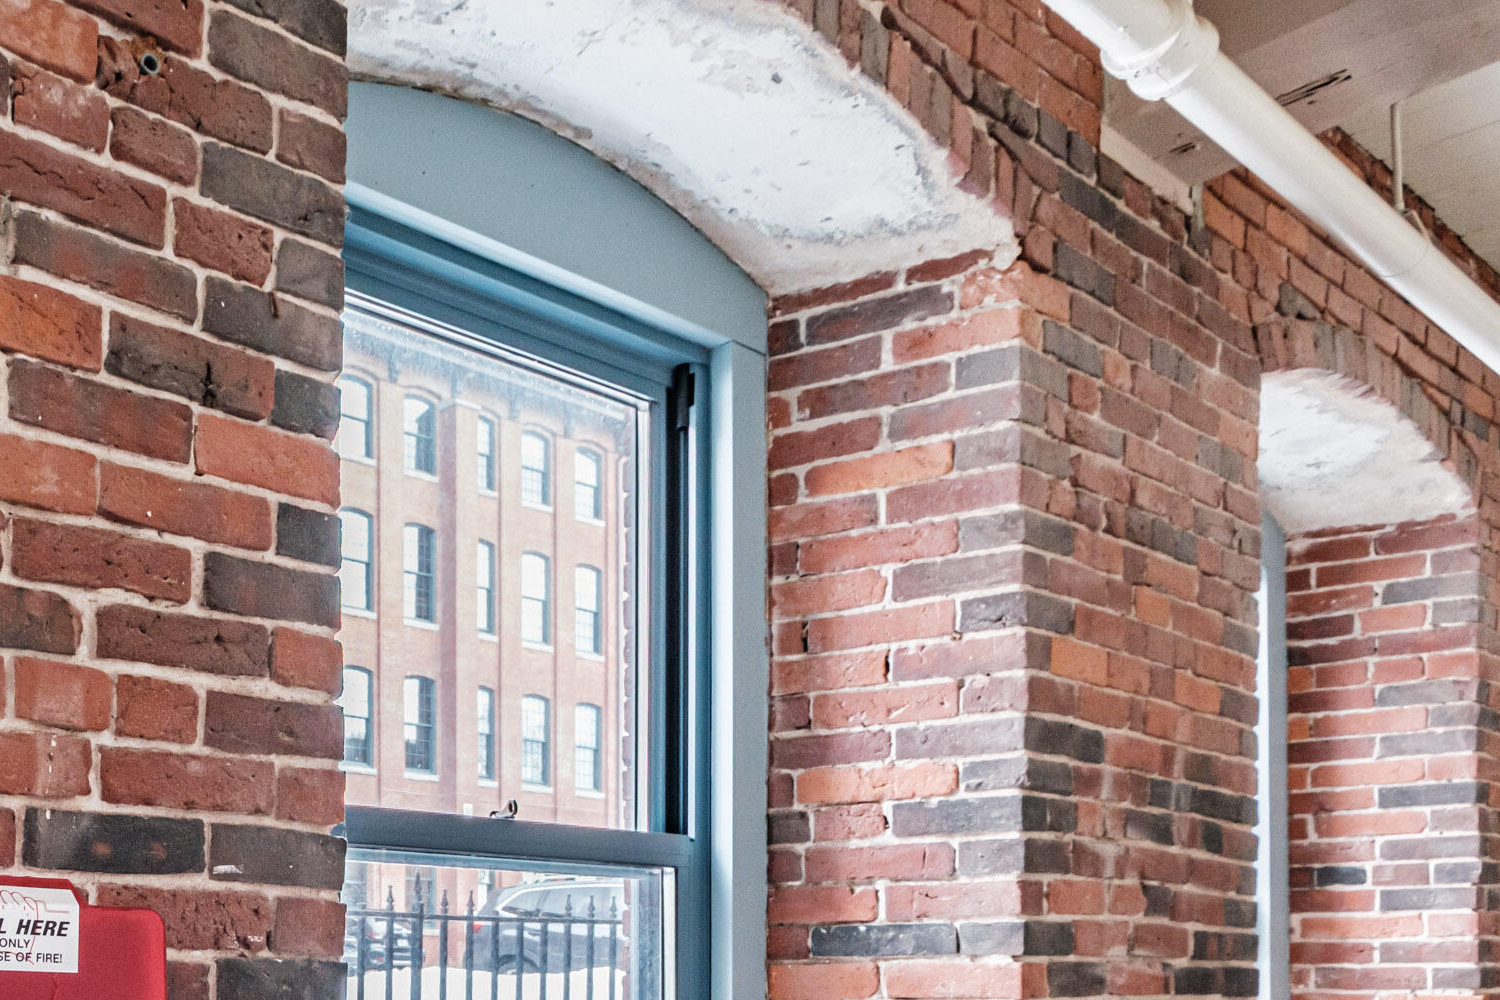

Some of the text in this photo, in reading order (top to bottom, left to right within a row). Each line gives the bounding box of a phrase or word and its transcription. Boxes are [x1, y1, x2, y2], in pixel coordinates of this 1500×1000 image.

[16, 918, 70, 937] HERE
[16, 952, 32, 962] OF
[36, 953, 63, 963] FIRE!
